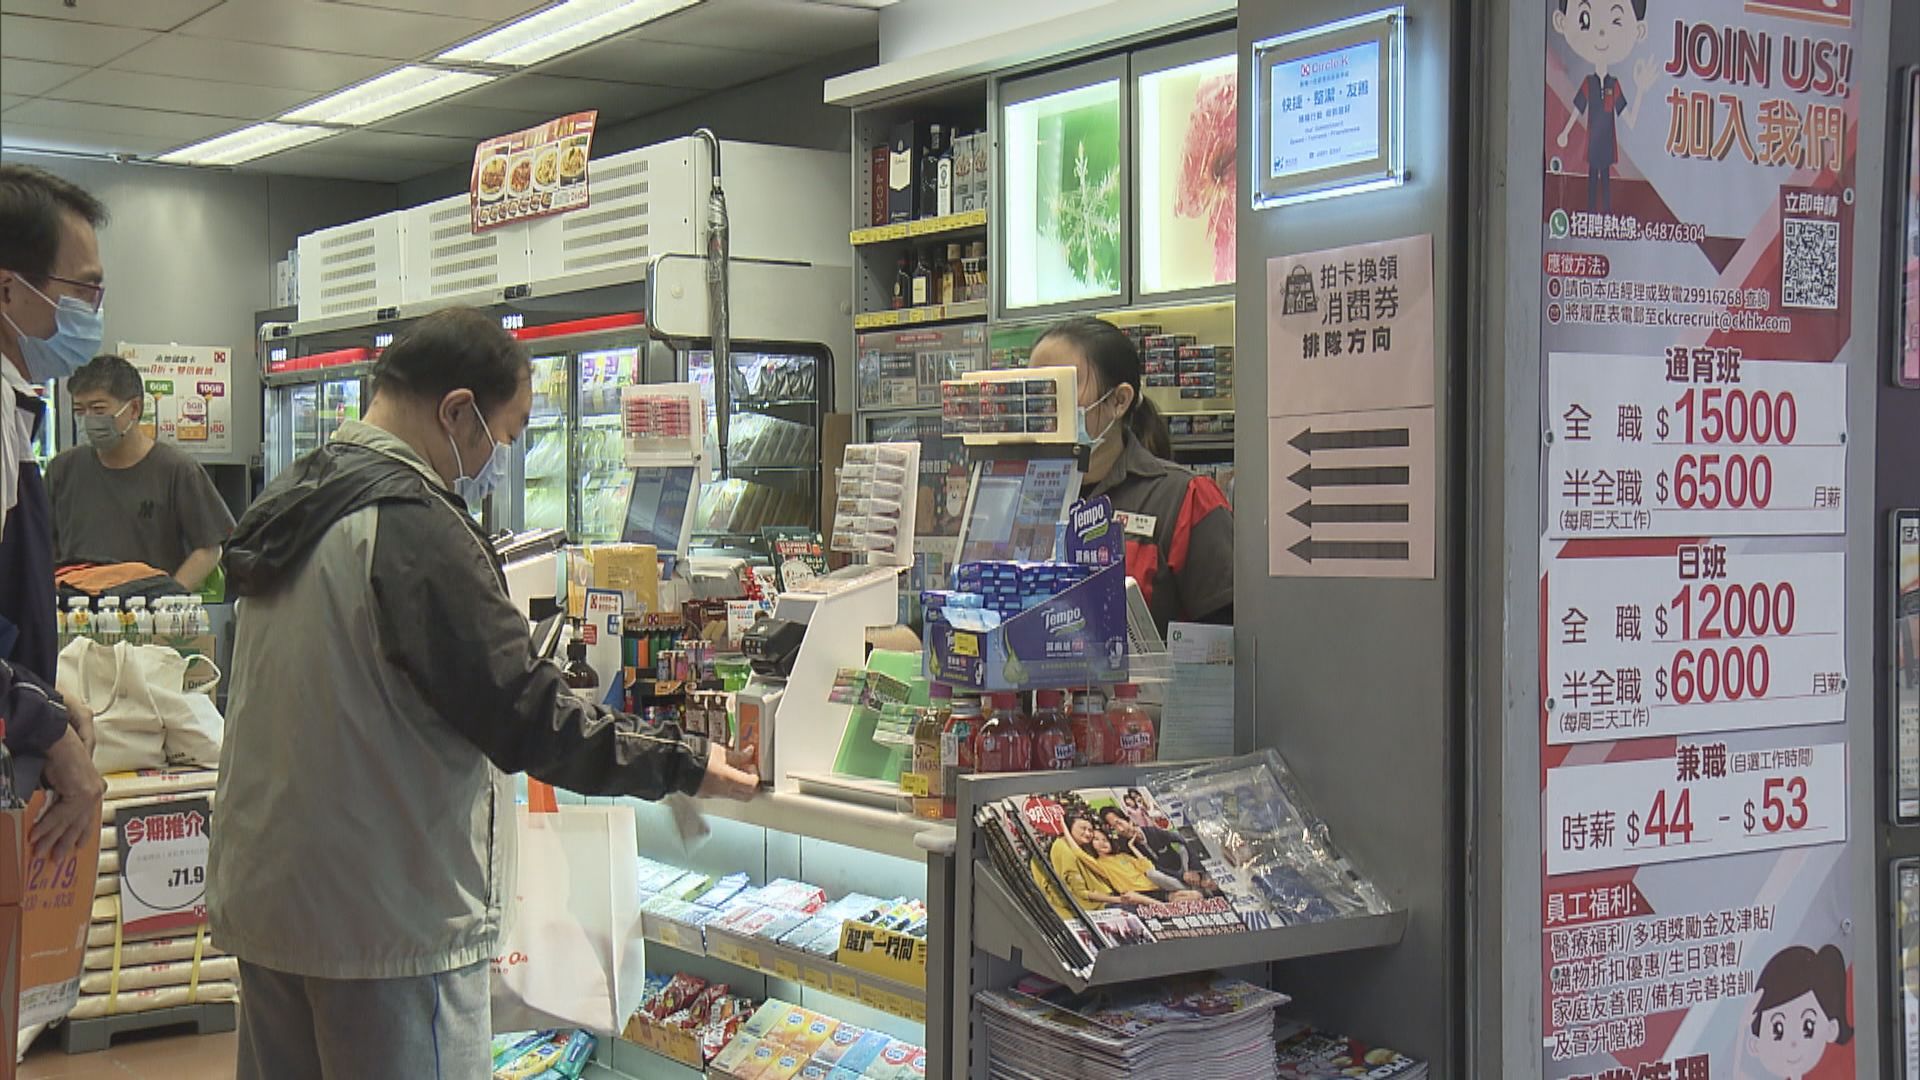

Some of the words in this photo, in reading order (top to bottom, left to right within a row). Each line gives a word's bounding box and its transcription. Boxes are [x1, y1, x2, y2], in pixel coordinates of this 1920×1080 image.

[1665, 20, 1769, 86] JOIN
[1781, 35, 1851, 97] US!
[1665, 87, 1846, 172] 加入我們
[1784, 192, 1838, 217] 立即申請
[1571, 211, 1641, 240] 招聘熱線:
[1645, 222, 1705, 243] 64876304
[1320, 255, 1398, 289] 拍卡換領
[1322, 285, 1399, 325] 消費券
[1303, 326, 1391, 359] 排隊方向
[1665, 348, 1740, 383] 通宵班
[1563, 404, 1592, 441] 全
[1617, 404, 1643, 442] 職
[1656, 388, 1797, 445] $15000
[1562, 469, 1643, 507] 半全職
[1656, 454, 1772, 509] $6500
[1813, 487, 1841, 509] 月薪
[1070, 504, 1104, 533] Tempo
[1559, 510, 1651, 531] (每周三天工作)
[1678, 546, 1727, 580] 日班
[1041, 607, 1081, 629] Tempo
[1561, 608, 1589, 644] 全
[1616, 604, 1642, 642] 職
[1655, 582, 1795, 641] $12000
[1562, 667, 1642, 708] 半全職
[1655, 644, 1770, 705] $6000
[1812, 672, 1841, 695] 月薪
[1559, 706, 1650, 733] (每周三天工作)
[1676, 744, 1727, 781] 兼職
[1730, 748, 1814, 773] (自選工作時間)
[125, 811, 204, 846] 今期推介
[1561, 810, 1616, 851] 時薪
[1627, 788, 1694, 846] $44
[1743, 775, 1809, 833] $53
[168, 866, 204, 888] $71.9
[1546, 884, 1637, 925] 員工福利:
[1553, 970, 1754, 1024] 家庭友善假/備有完善培訓
[1553, 1017, 1645, 1058] 及晉升階梯
